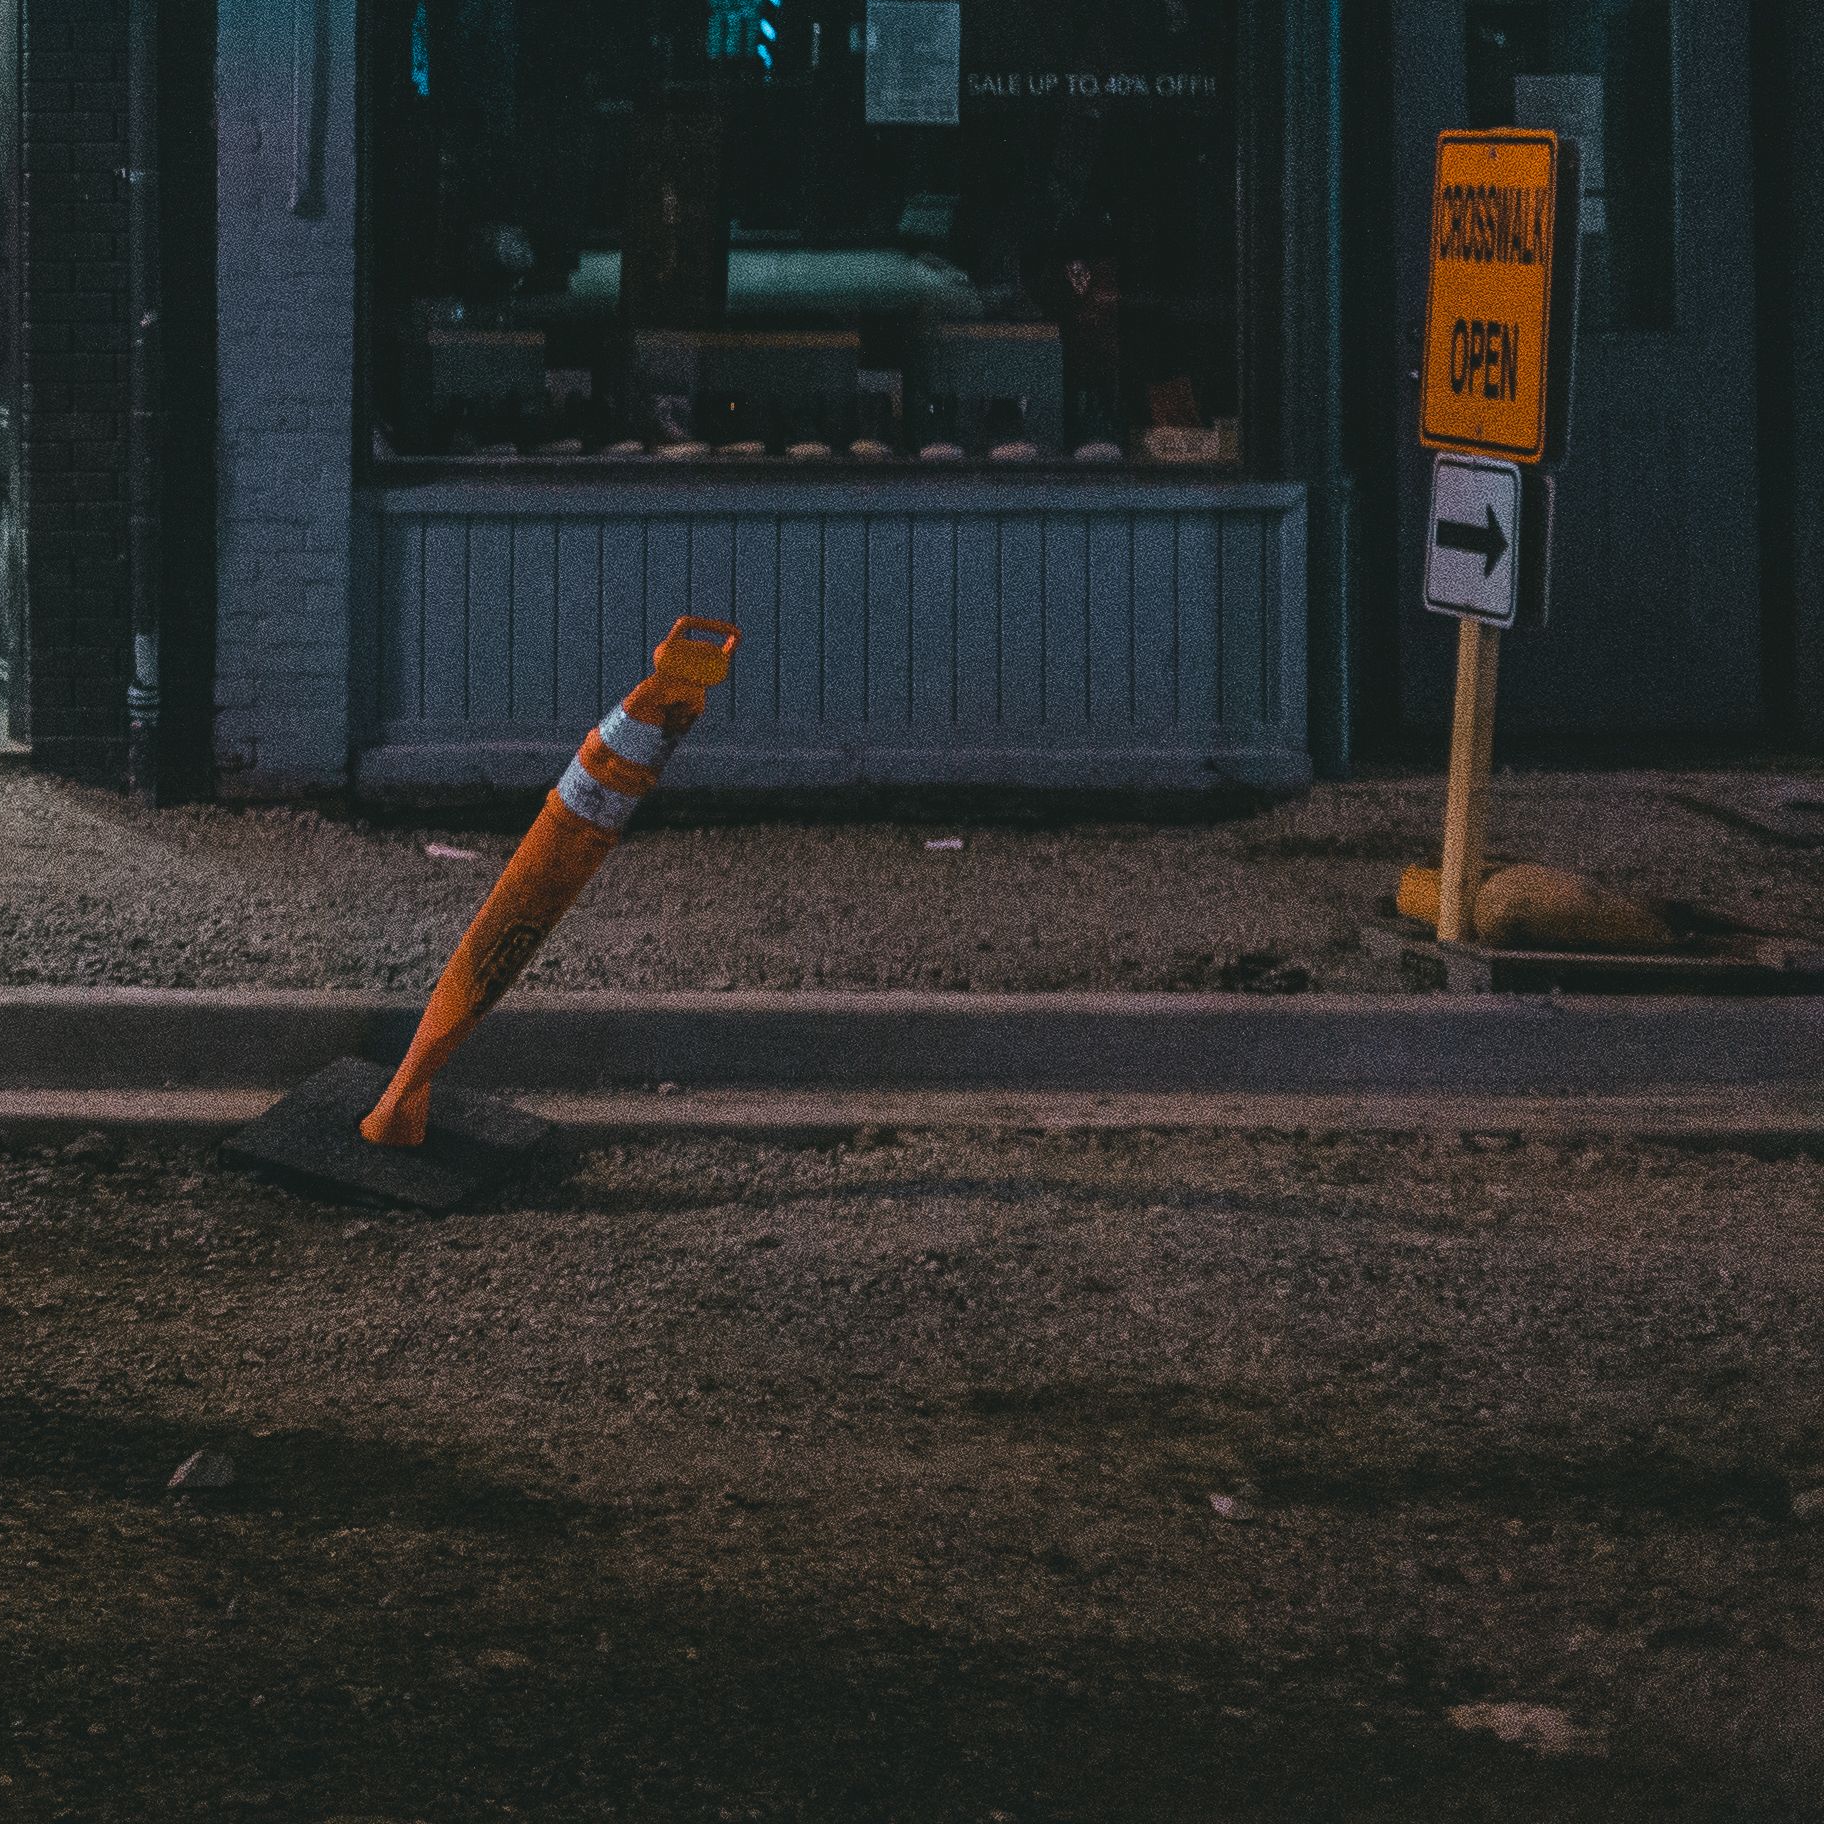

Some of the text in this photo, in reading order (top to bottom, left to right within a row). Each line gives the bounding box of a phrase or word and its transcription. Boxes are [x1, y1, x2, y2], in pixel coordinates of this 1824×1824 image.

[967, 72, 1023, 97] SALE
[1028, 72, 1058, 97] UP
[1066, 72, 1100, 97] TO
[1438, 183, 1548, 265] CROSSWALK
[1450, 317, 1519, 402] OPEN
